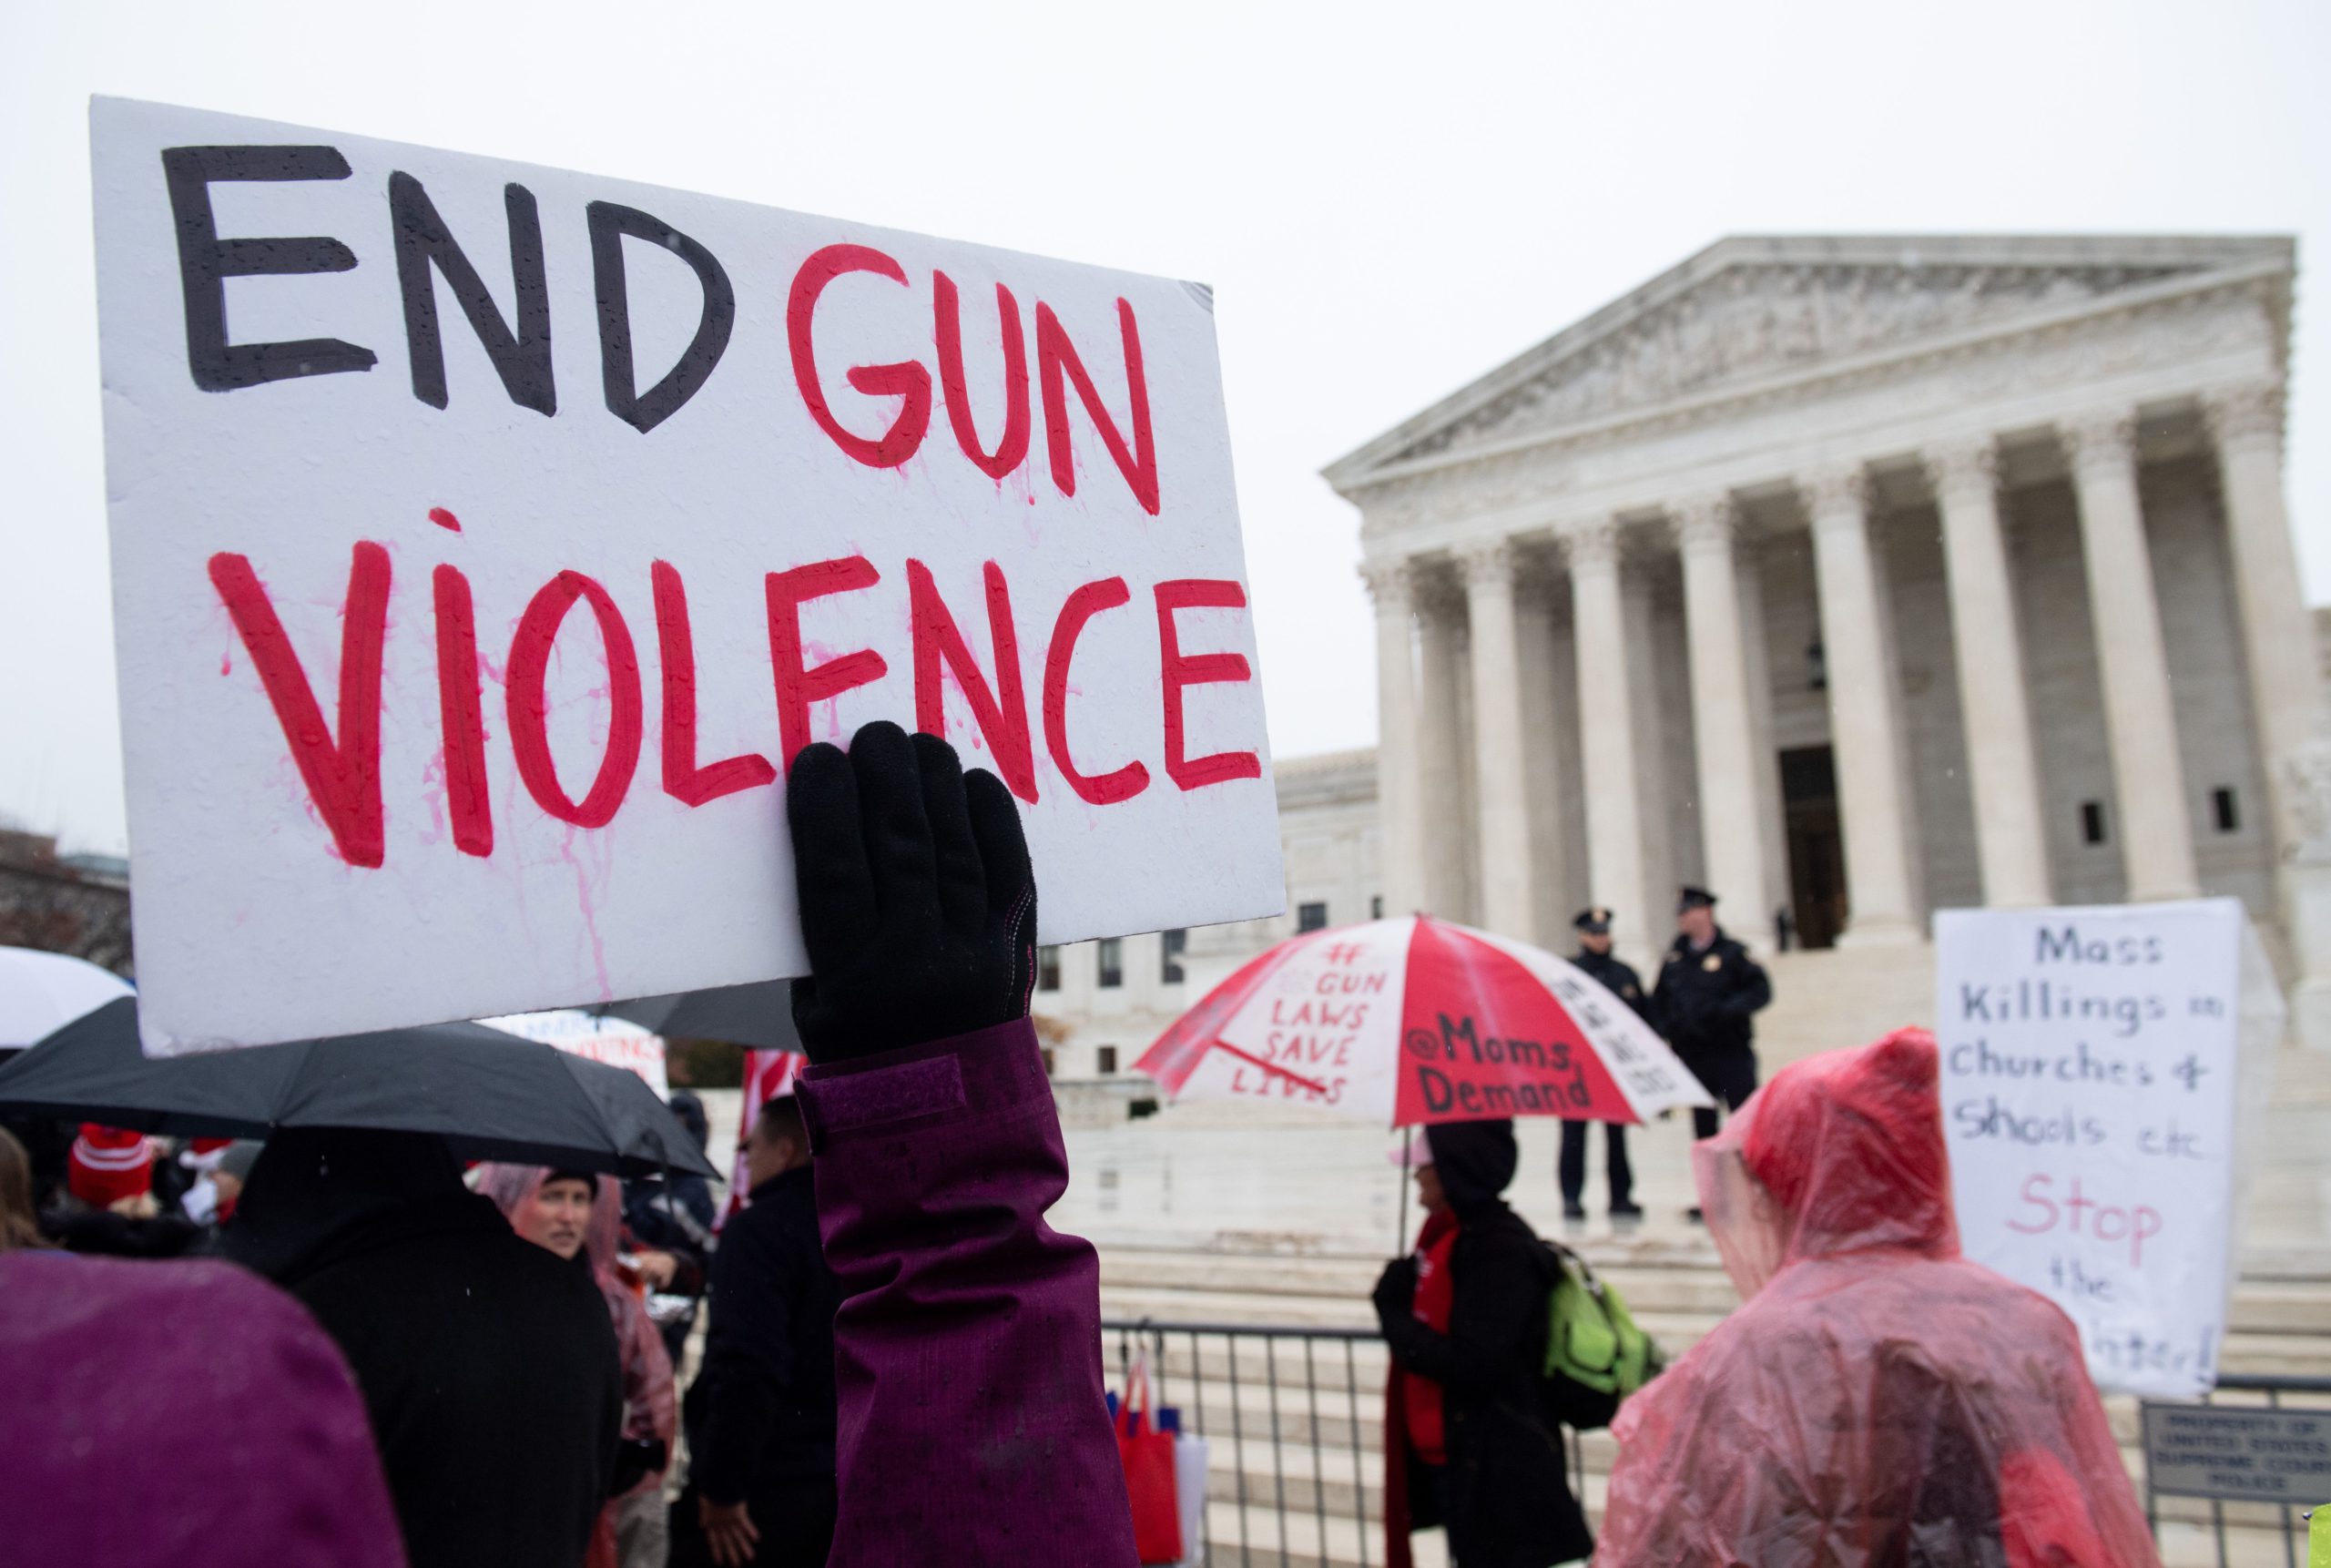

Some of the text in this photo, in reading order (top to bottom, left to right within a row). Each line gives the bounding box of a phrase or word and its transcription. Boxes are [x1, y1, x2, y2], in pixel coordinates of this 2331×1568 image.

[161, 145, 1160, 516] END GUN
[2036, 924, 2164, 965] Mass
[1316, 970, 1387, 995] GUN
[1960, 978, 2167, 1037] Killings
[1271, 999, 1369, 1031] LAWS
[1263, 1031, 1357, 1067] SAVE
[1405, 1012, 1572, 1073] @Moms
[1231, 1067, 1348, 1105] LIVES
[1418, 1062, 1592, 1114] Demand
[2006, 1171, 2163, 1269] Stop
[2048, 1253, 2118, 1303] the
